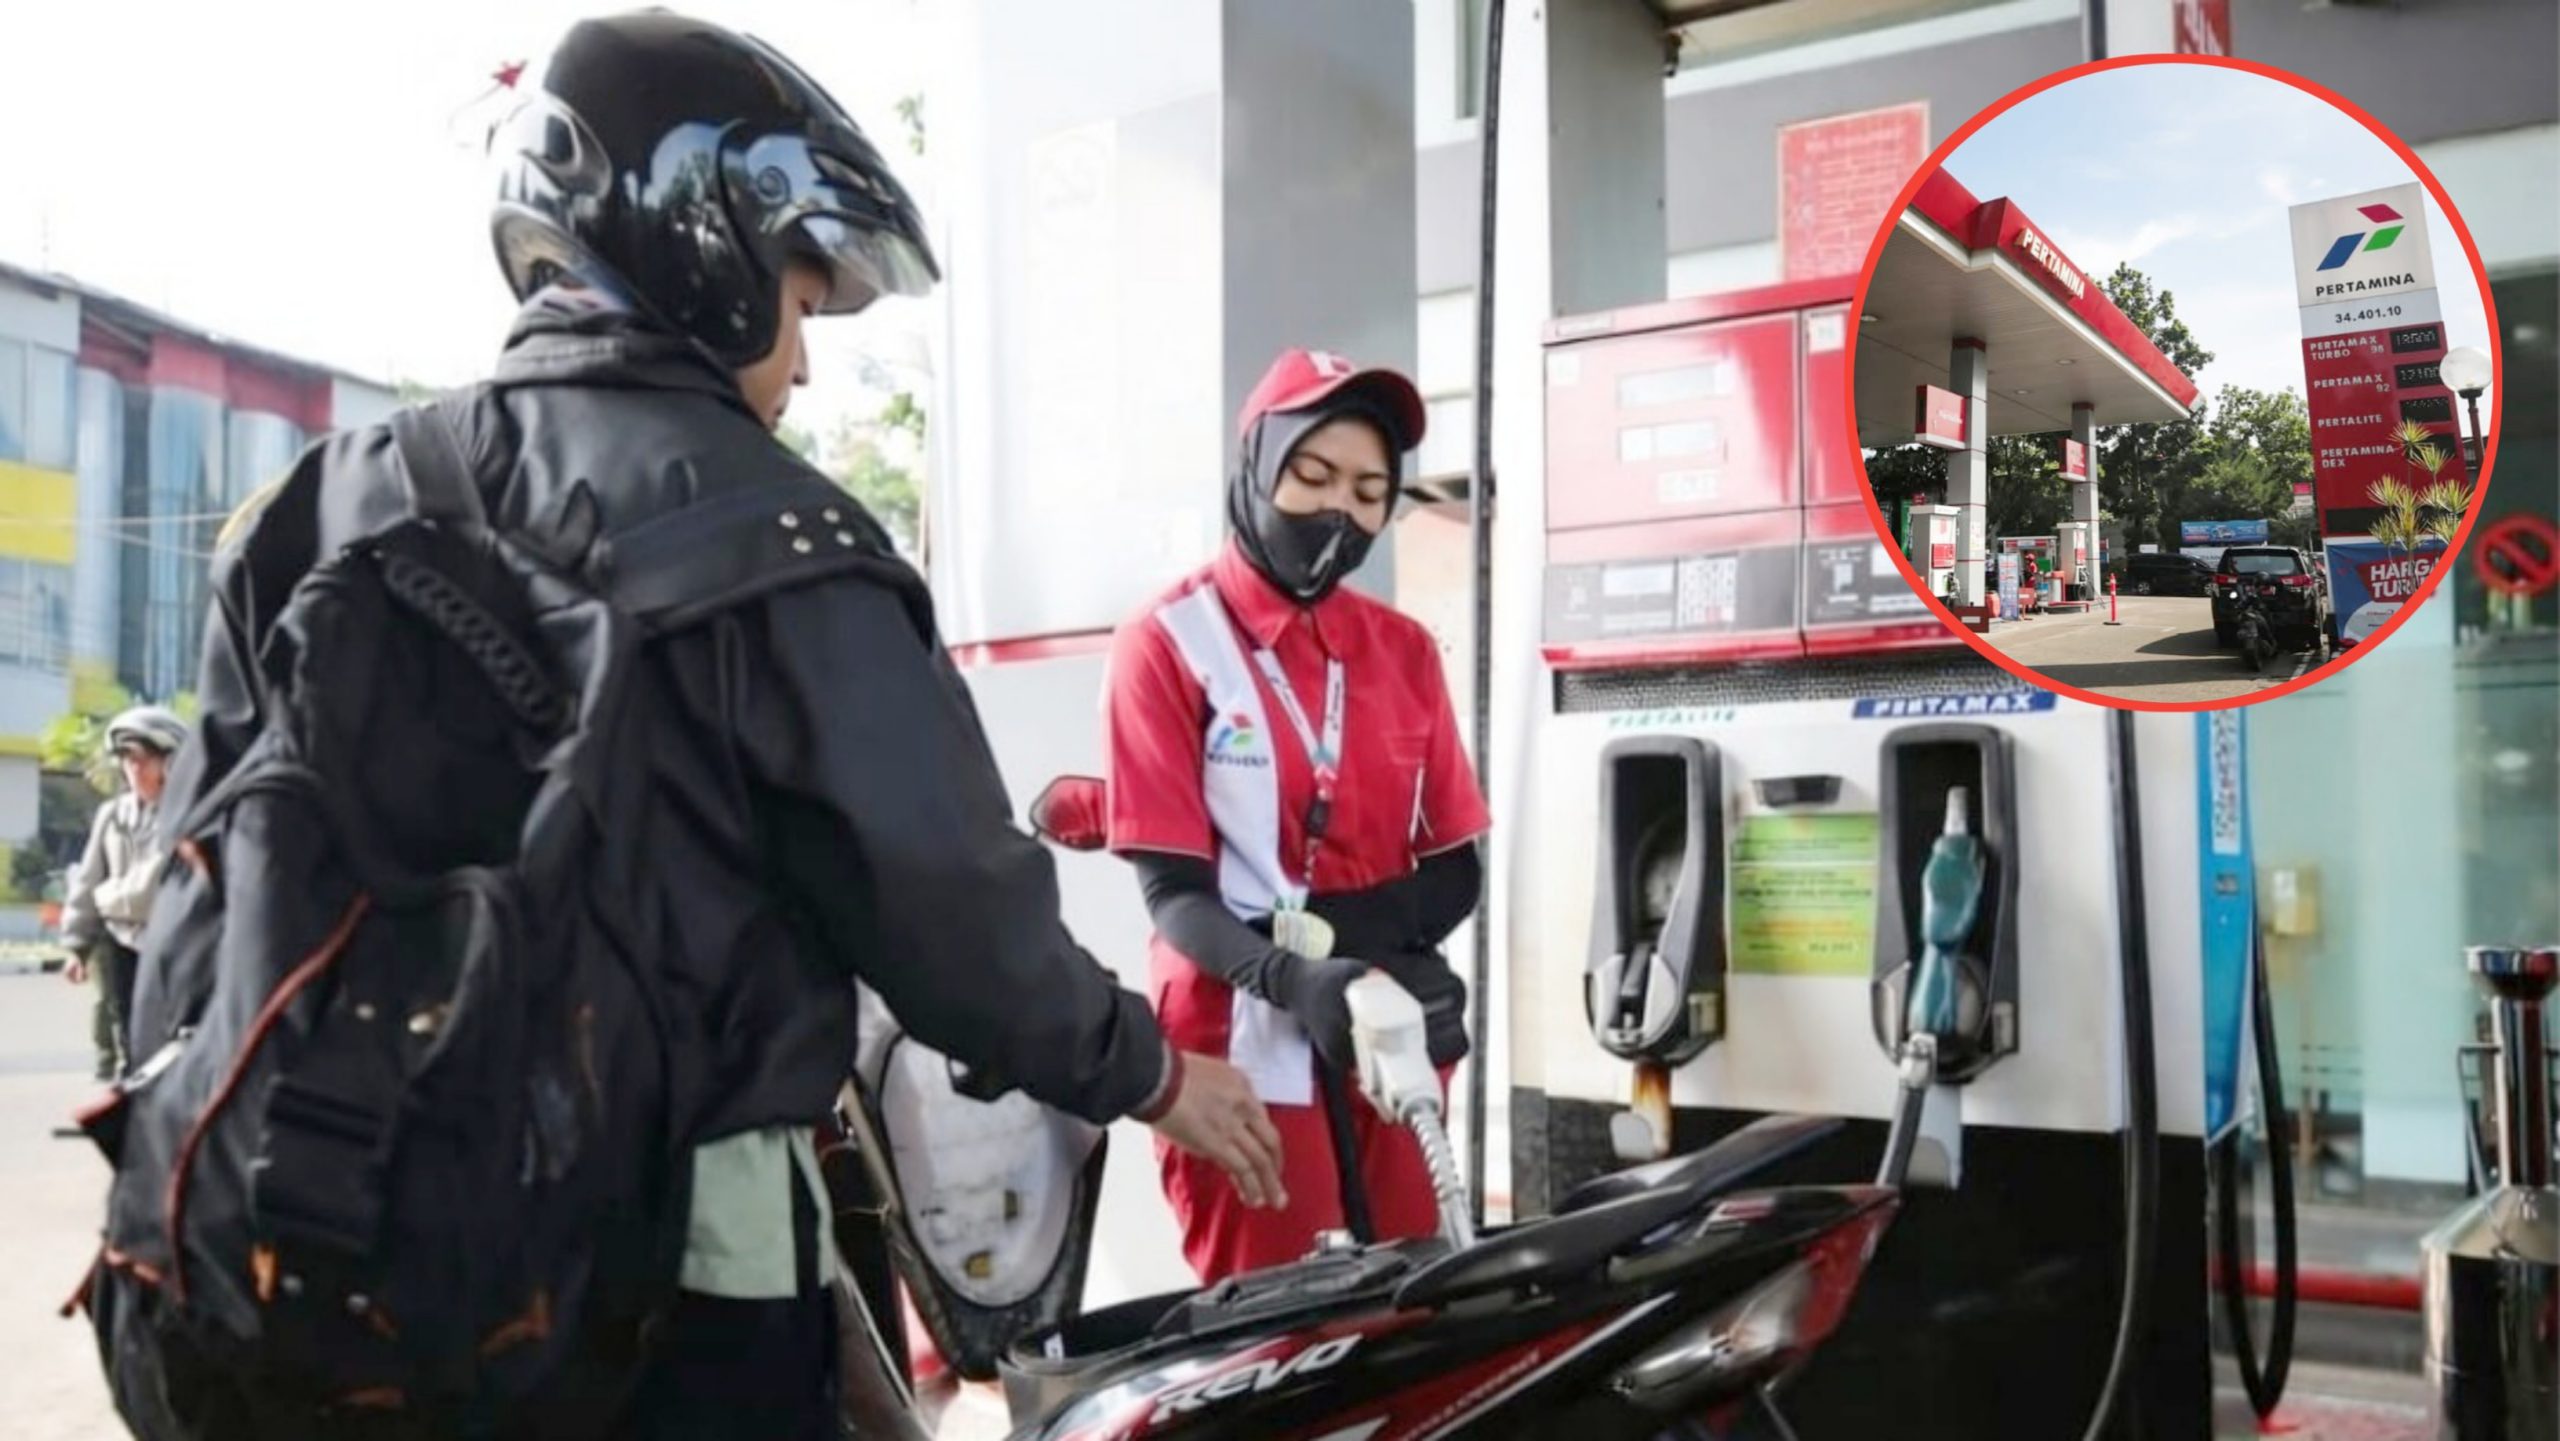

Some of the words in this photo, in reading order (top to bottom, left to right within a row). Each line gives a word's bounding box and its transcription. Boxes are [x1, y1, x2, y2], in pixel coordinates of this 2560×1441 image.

[2022, 227, 2085, 299] PERTAMINA
[2316, 273, 2415, 297] PERTAMINA
[2335, 305, 2402, 324] 34.401.10
[2310, 336, 2377, 351] PERTAMAX
[2311, 349, 2351, 361] TURBO
[2314, 374, 2383, 389] PERTAMAX
[2376, 383, 2391, 393] 92
[2318, 414, 2383, 428] PERTALITE
[2321, 444, 2395, 458] PERTAMINA
[2322, 458, 2346, 468] DEX
